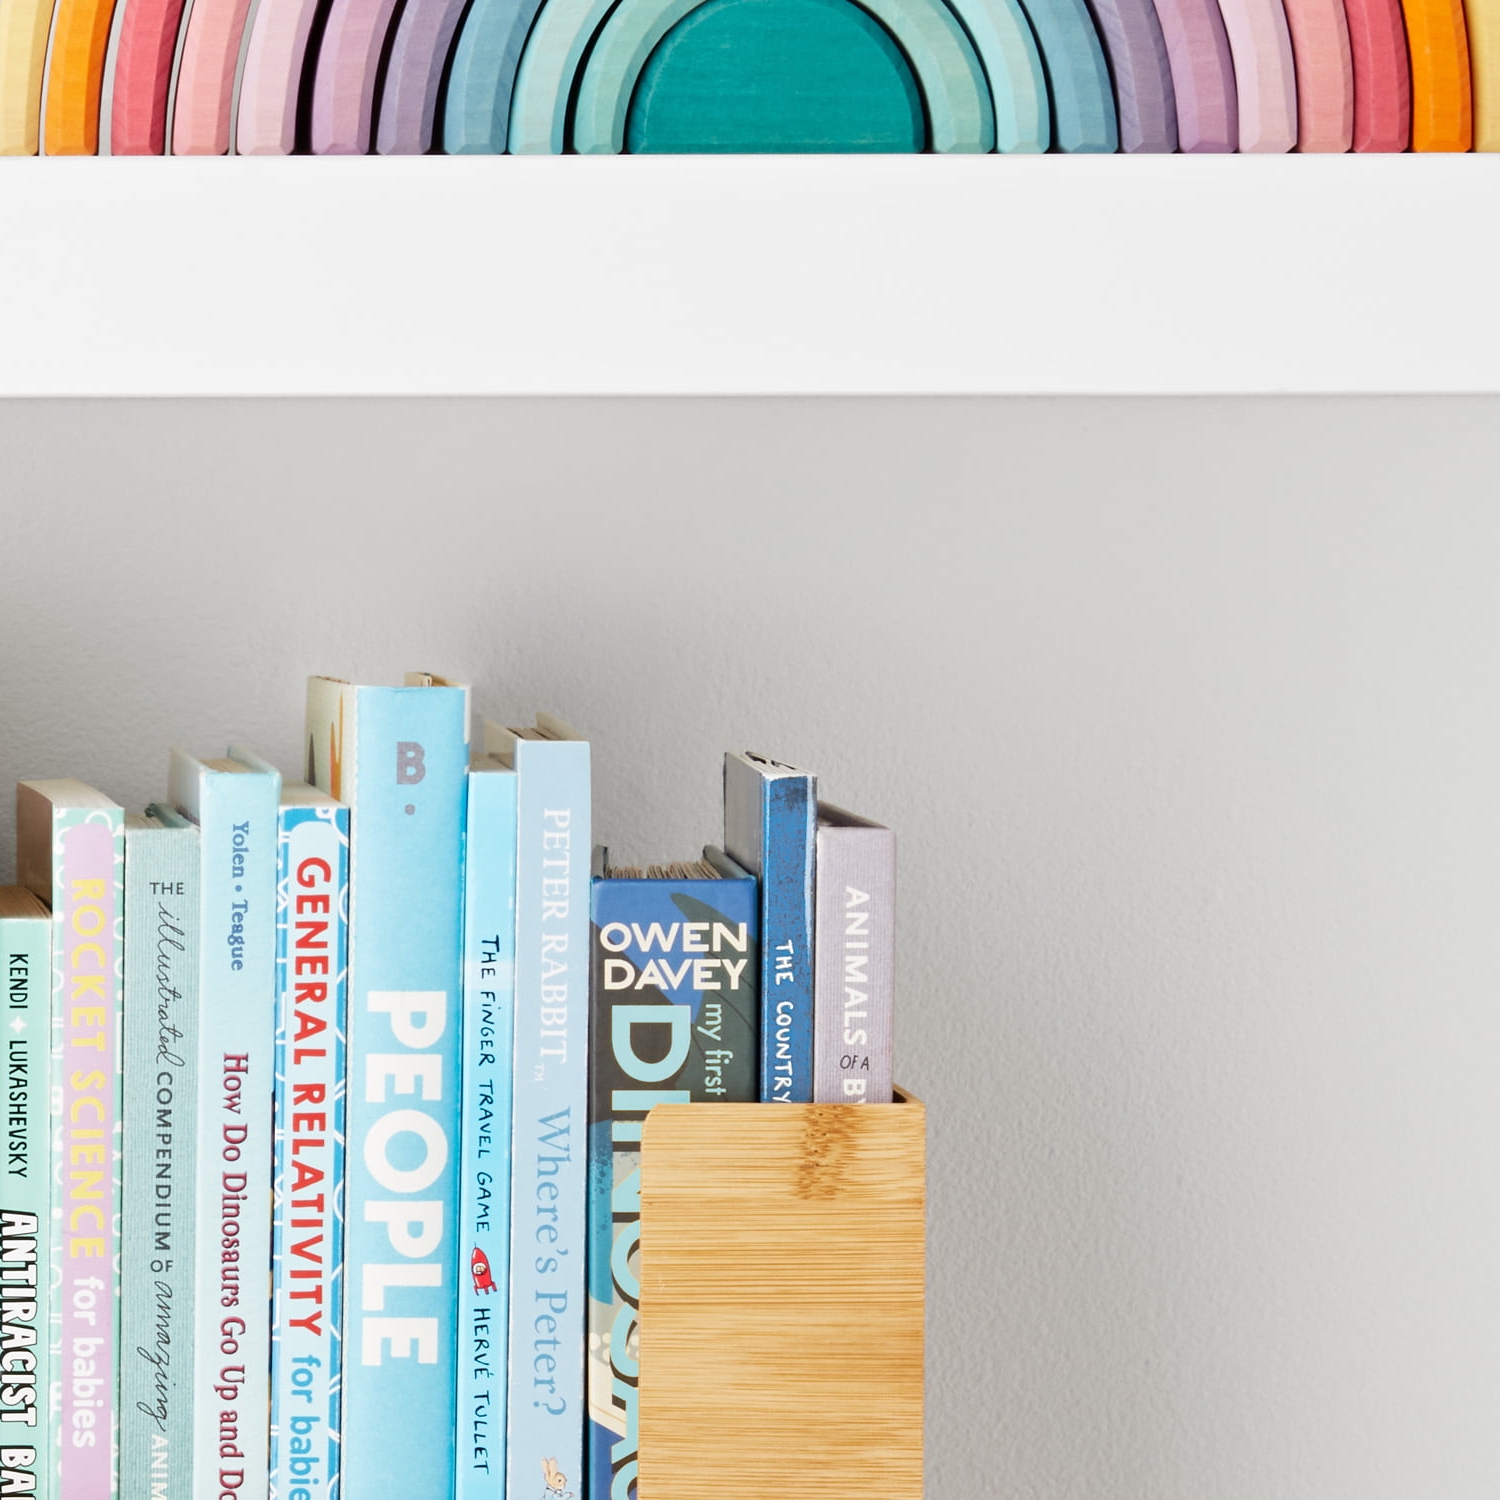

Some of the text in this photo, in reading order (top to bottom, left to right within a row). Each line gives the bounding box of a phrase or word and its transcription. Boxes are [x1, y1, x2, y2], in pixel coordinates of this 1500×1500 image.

[150, 882, 185, 895] THE
[227, 821, 250, 971] Yolen Teague
[292, 857, 331, 1065] GENERAL
[480, 935, 500, 979] THE
[540, 808, 571, 1065] PETER RABBIT
[600, 922, 747, 952] OWEN
[604, 959, 748, 990] DAVEY
[775, 939, 794, 986] THE
[843, 886, 871, 1047] ANIMALS
[8, 953, 28, 1178] KENDI LUKASHEVSKY
[154, 901, 186, 1251] illustrated COMPENDIUM
[223, 1053, 249, 1114] How
[697, 1003, 733, 1096] my first
[840, 1055, 869, 1070] OF A
[222, 1123, 248, 1161] Do
[477, 1080, 494, 1158] TRAVEL
[69, 878, 106, 1448] ROCKET SCIENCE for babies
[361, 990, 447, 1366] PEOPLE
[476, 1171, 493, 1232] GAME
[220, 1172, 248, 1308] Dinosaurs
[289, 1083, 326, 1336] RELATIVITY
[532, 1105, 572, 1416] Where's Peter?
[0, 1209, 38, 1428] ANTIRACIST
[136, 1281, 173, 1432] amazing
[220, 1317, 246, 1355] Go
[213, 1364, 245, 1401] Up
[290, 1355, 321, 1403] for
[219, 1411, 245, 1459] and
[473, 1390, 490, 1475] TULLET
